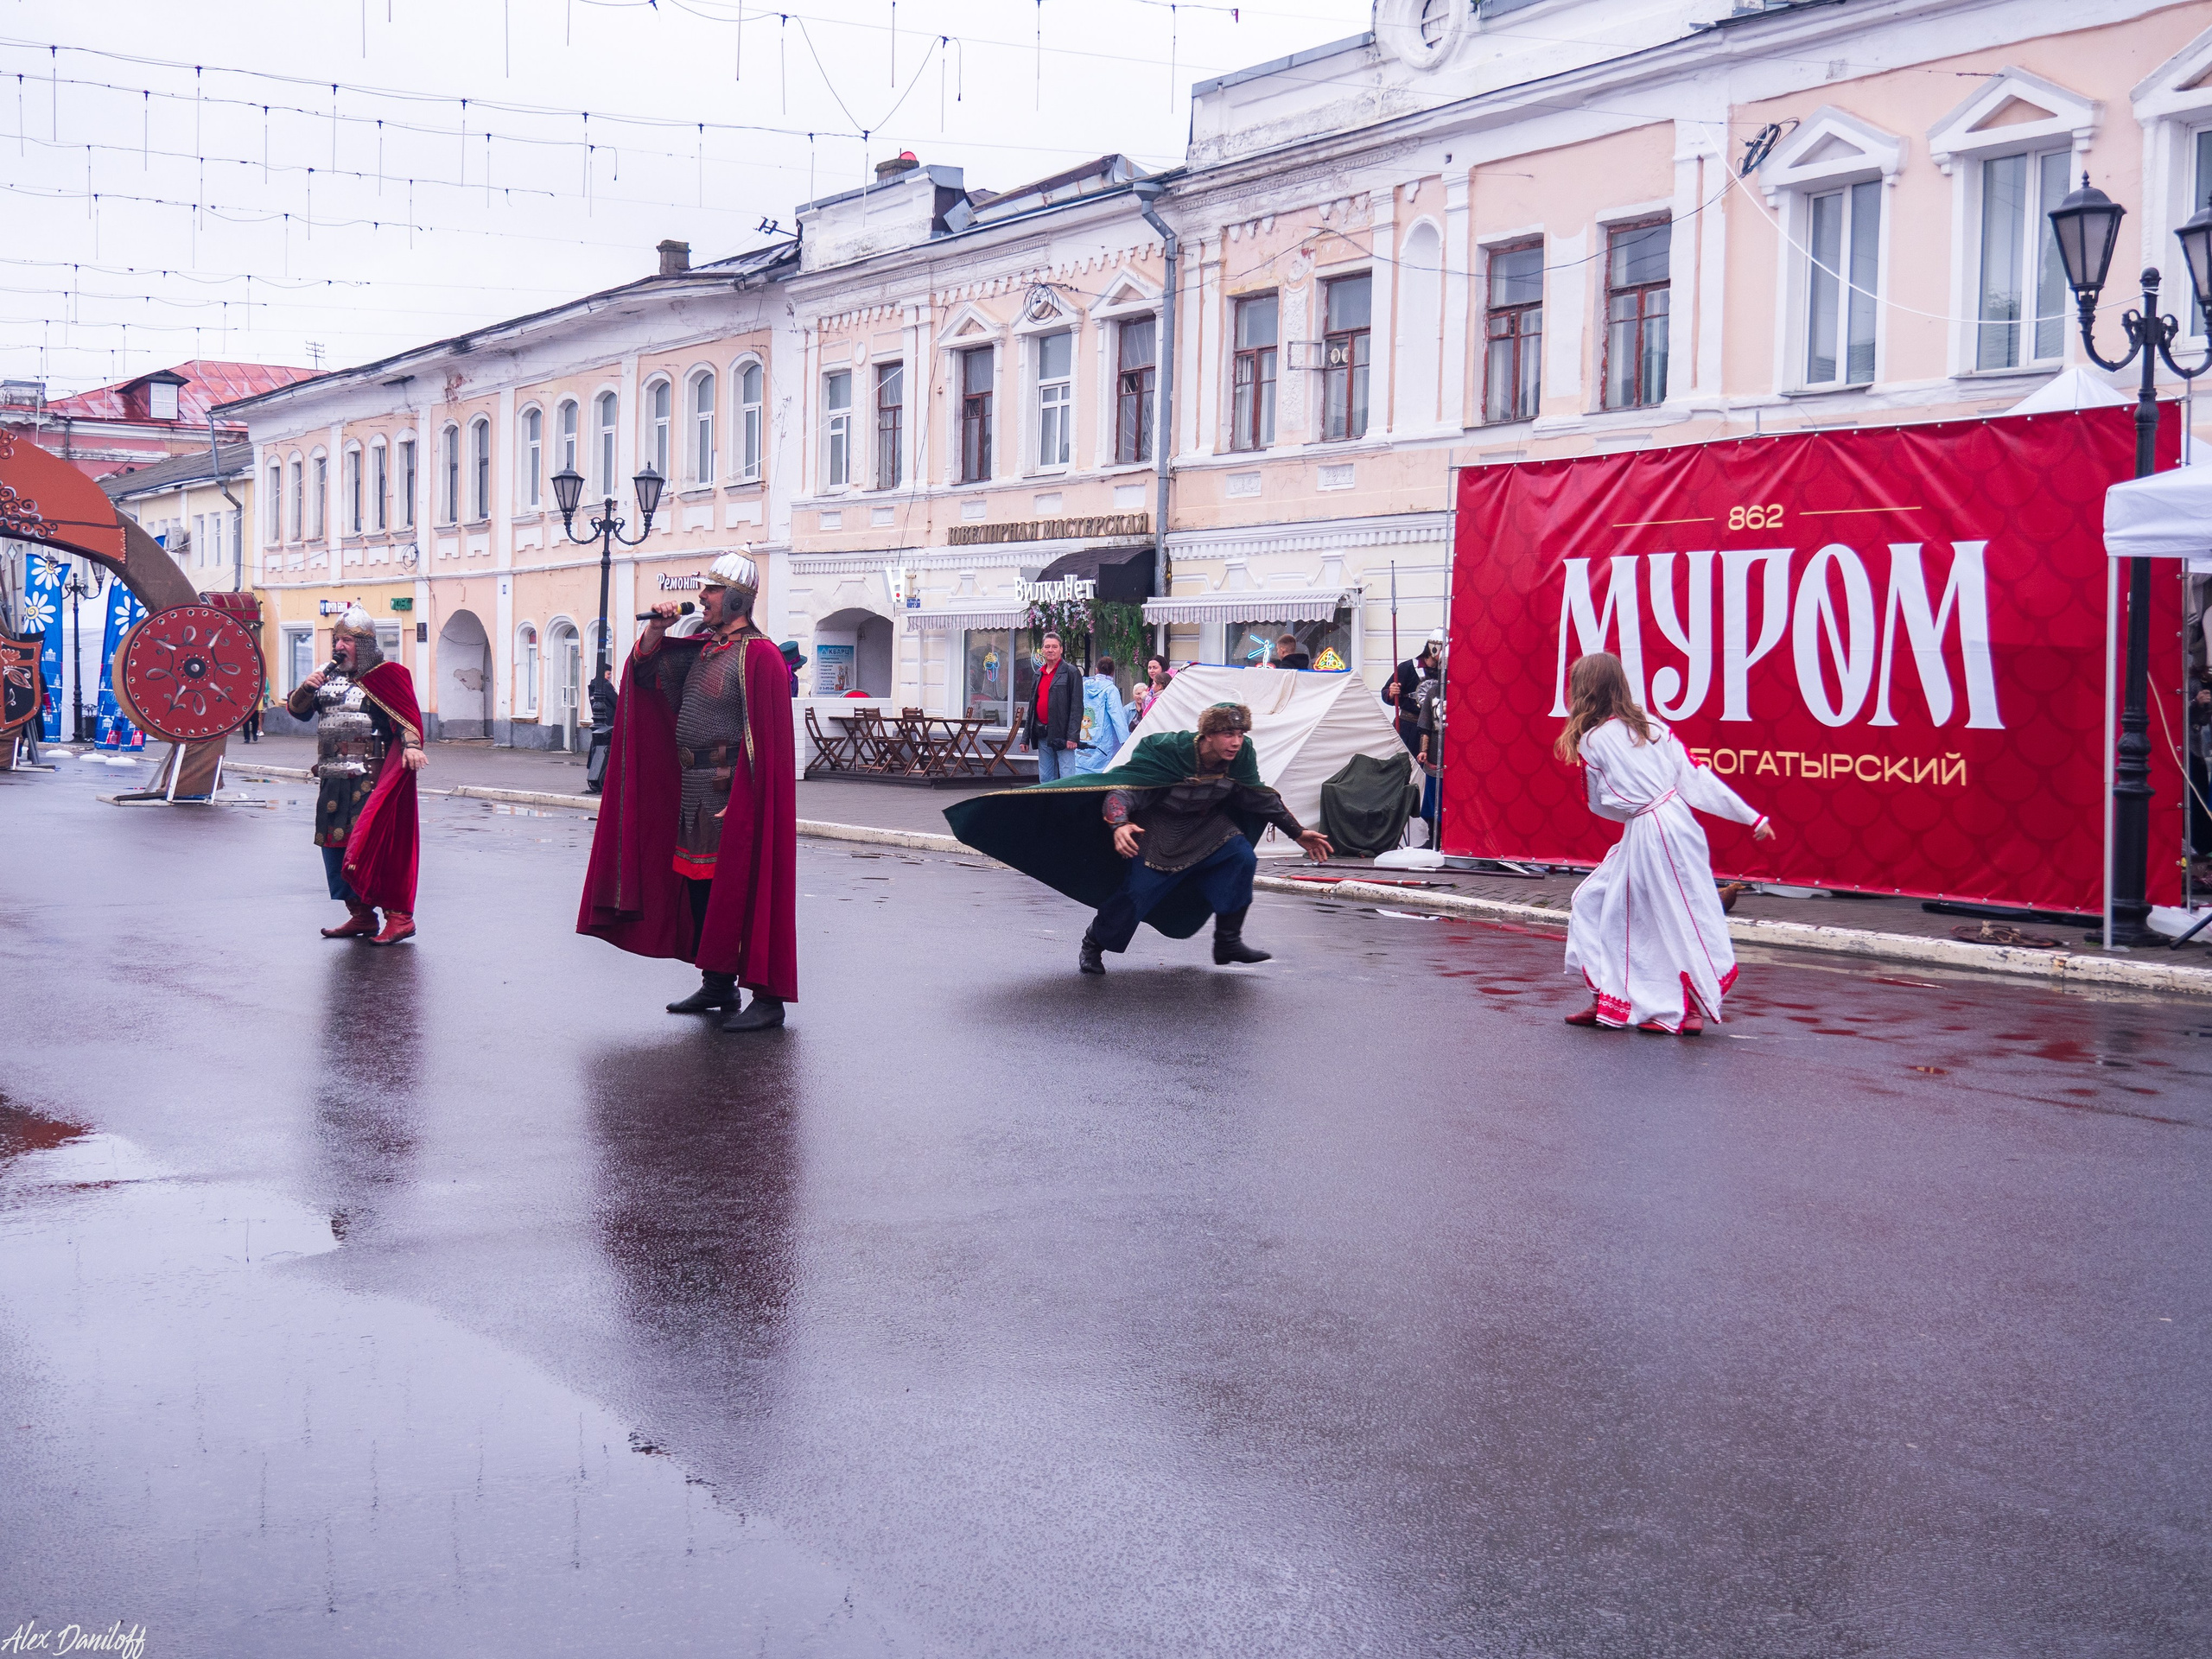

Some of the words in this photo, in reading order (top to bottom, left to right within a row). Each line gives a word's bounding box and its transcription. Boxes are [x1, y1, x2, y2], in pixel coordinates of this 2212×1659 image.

[948, 521, 1038, 545] ЮВЕЛИРНАЯ
[1043, 513, 1148, 538] МАСТЕРСКАЯ
[1728, 504, 1783, 531] 862
[1548, 540, 2005, 729] МУРОМ
[1690, 747, 1967, 785] БОГАТЫРСКИЙ
